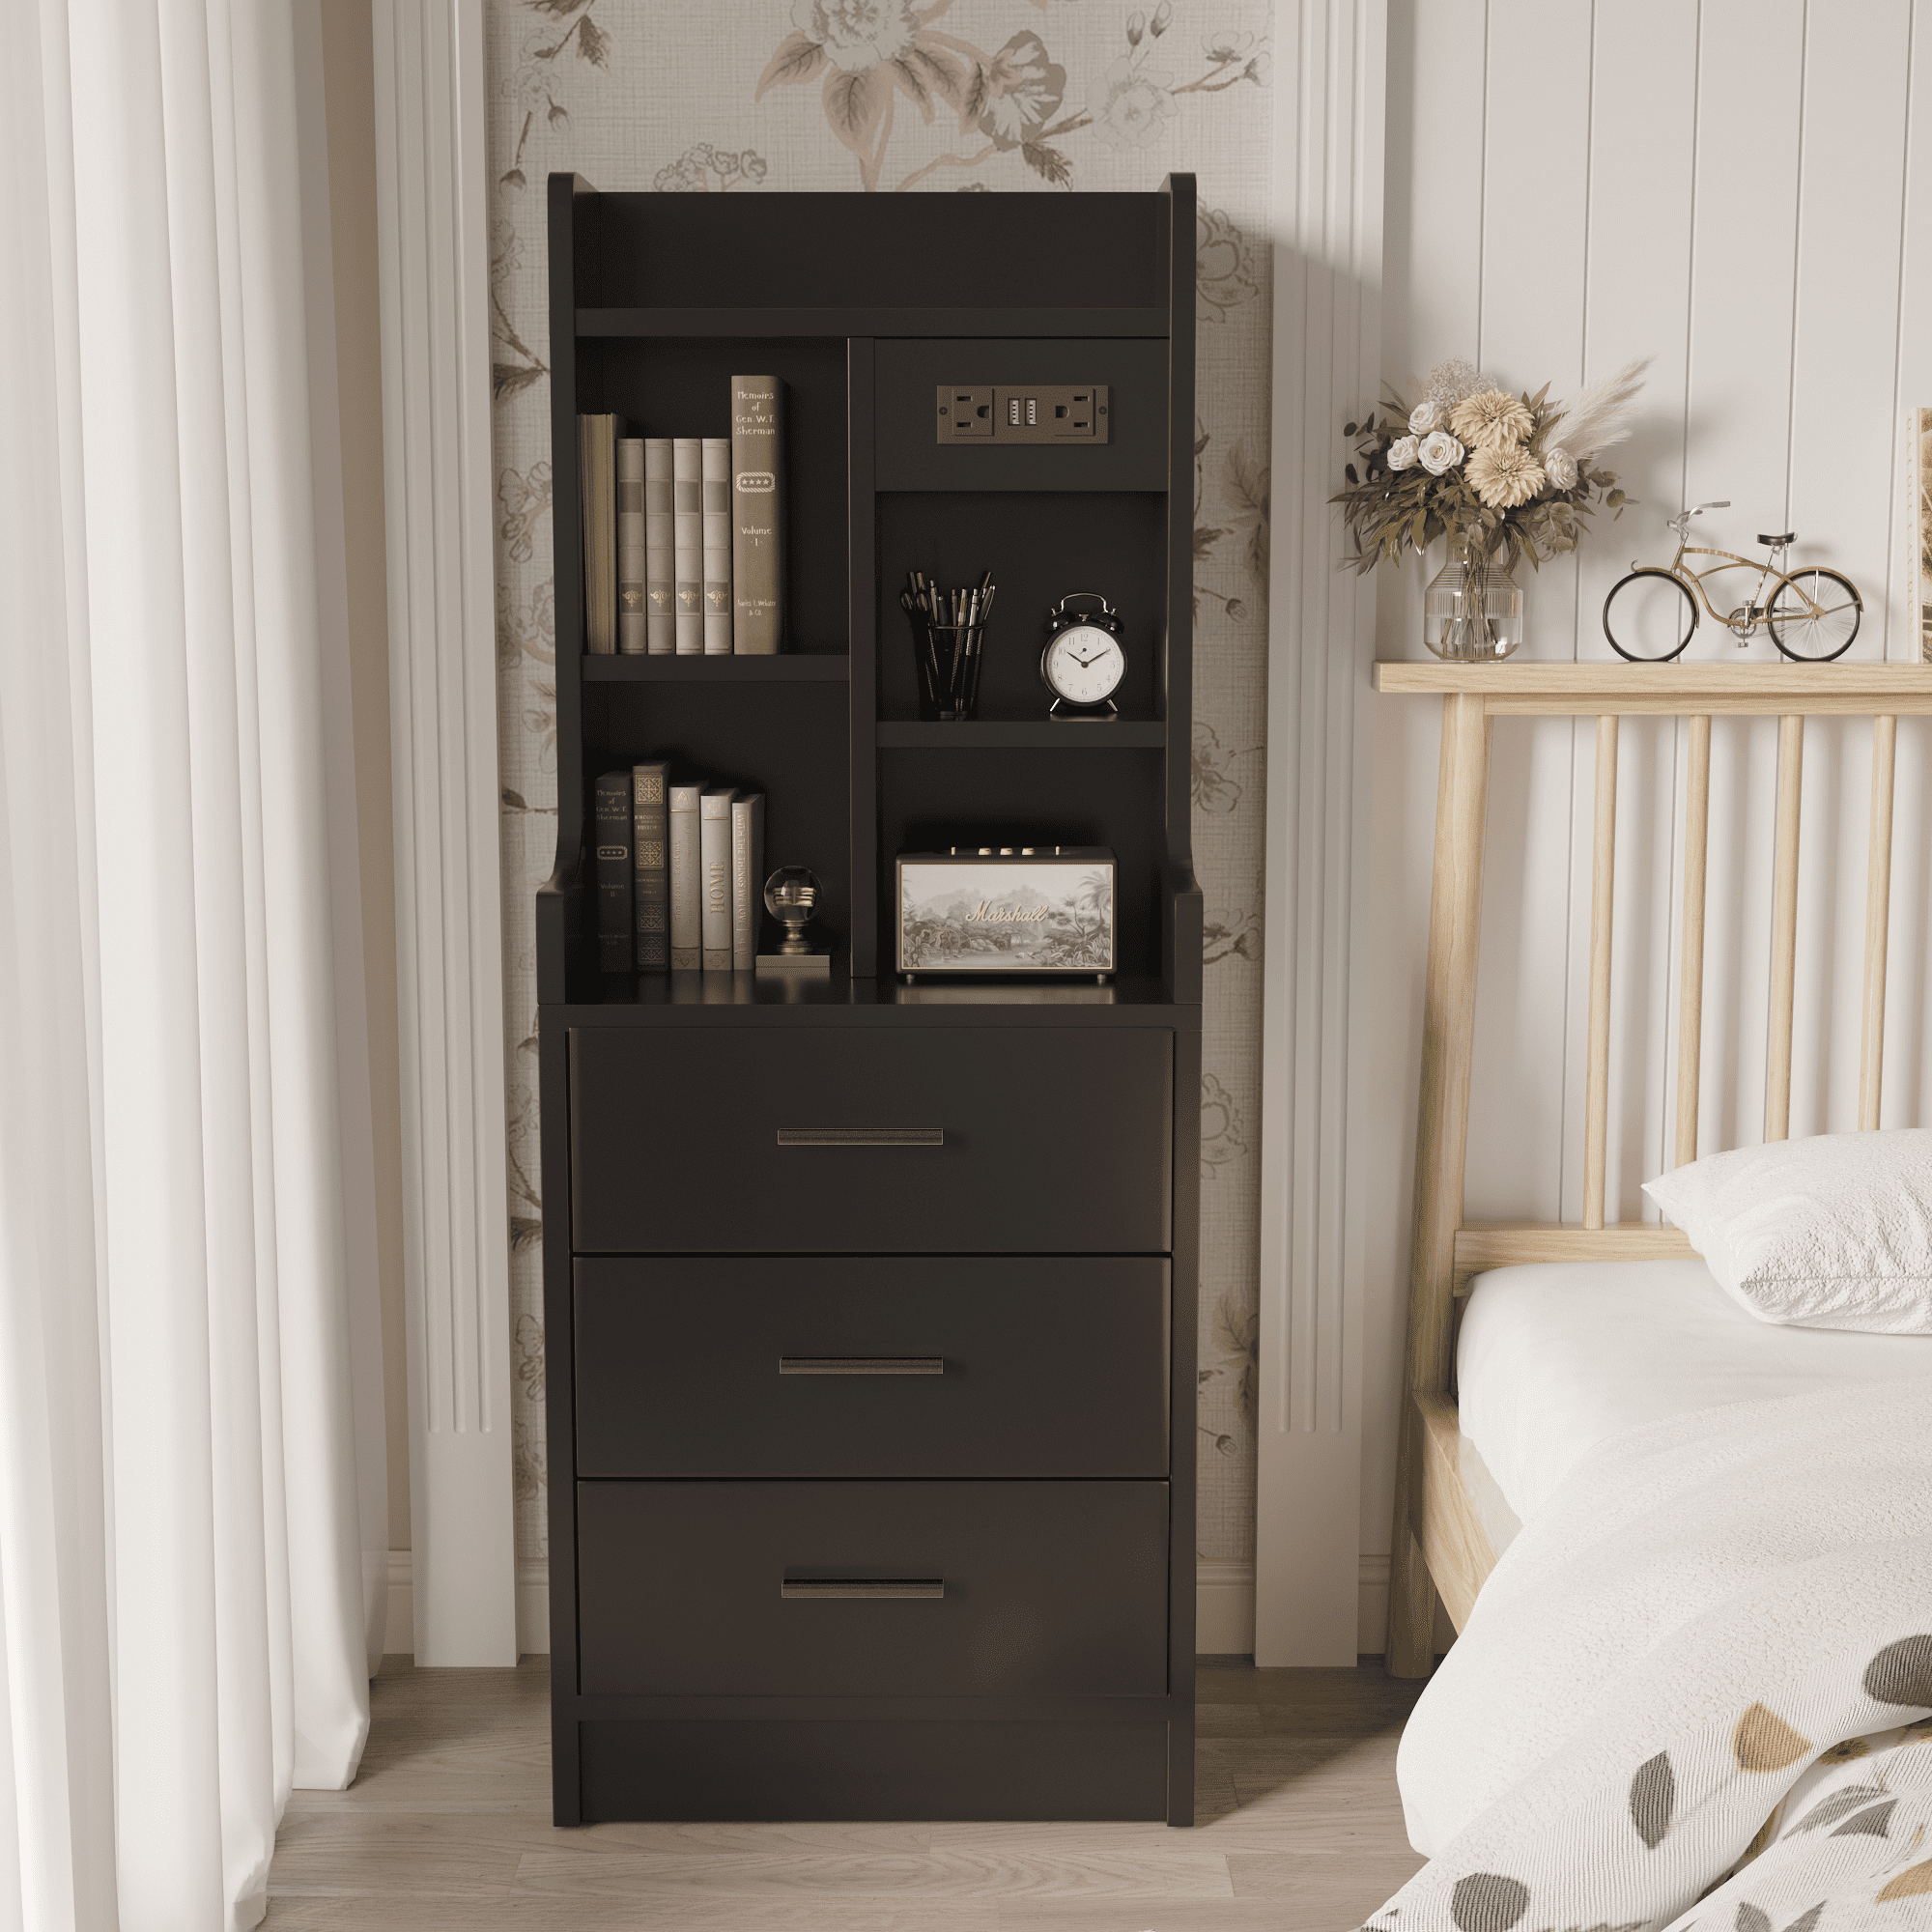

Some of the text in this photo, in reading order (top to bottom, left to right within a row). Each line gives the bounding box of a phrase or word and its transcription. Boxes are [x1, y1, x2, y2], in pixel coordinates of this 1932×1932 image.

[737, 390, 774, 400] Memoirs
[751, 401, 761, 412] of
[735, 426, 776, 436] Sherman
[741, 526, 772, 535] Volume
[736, 813, 748, 926] WITH THE THINGS WE LOVE
[709, 861, 724, 914] HOME
[966, 900, 1049, 922] Marshall
